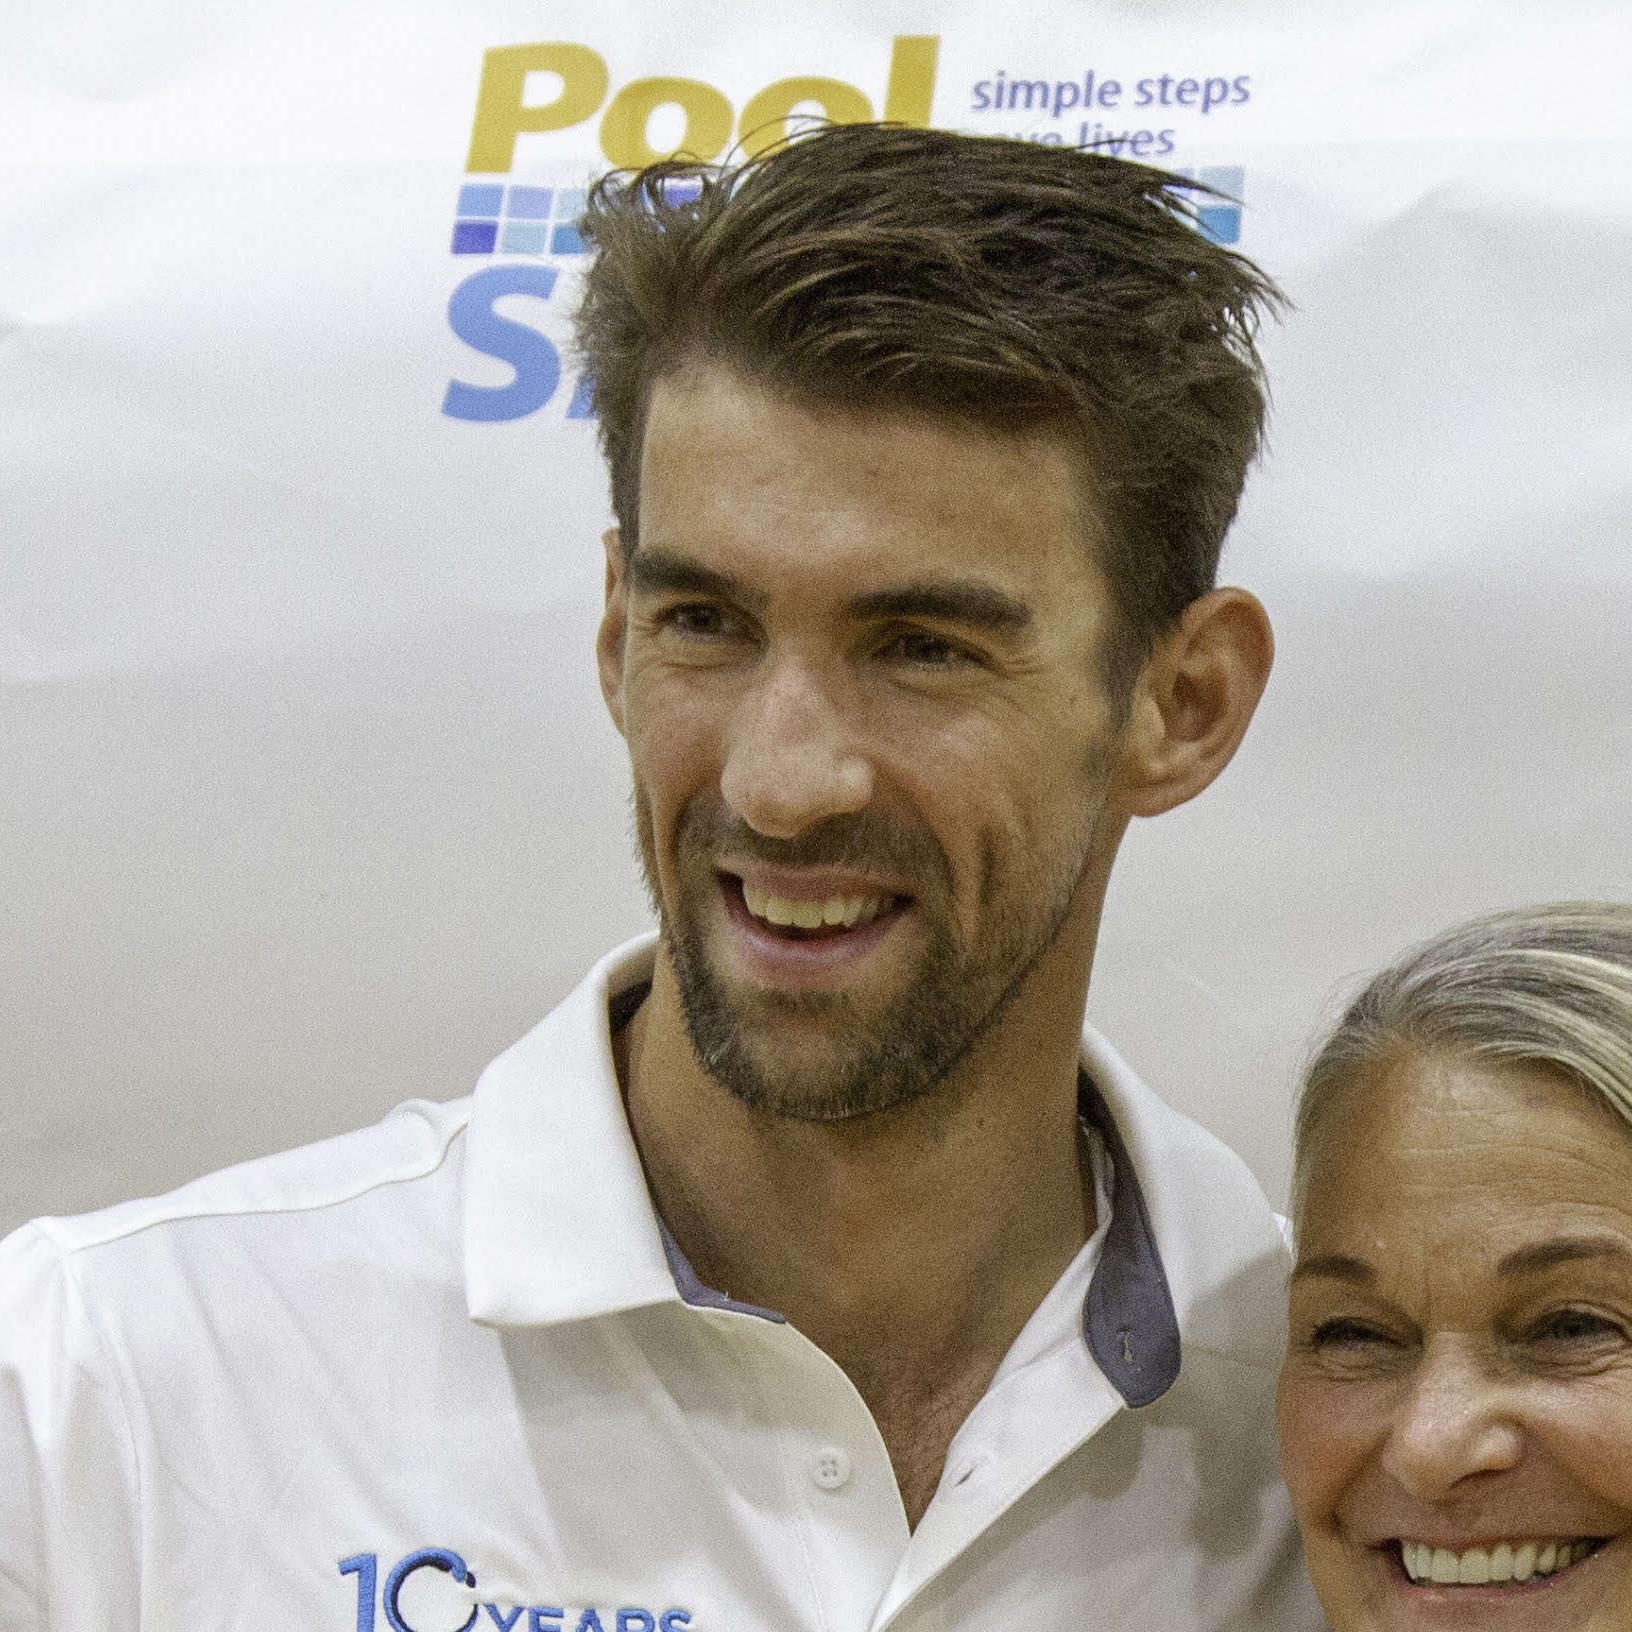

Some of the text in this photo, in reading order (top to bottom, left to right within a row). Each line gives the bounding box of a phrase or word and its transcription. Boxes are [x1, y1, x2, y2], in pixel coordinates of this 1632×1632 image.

[463, 35, 941, 173] Pool
[973, 69, 1250, 118] simple steps
